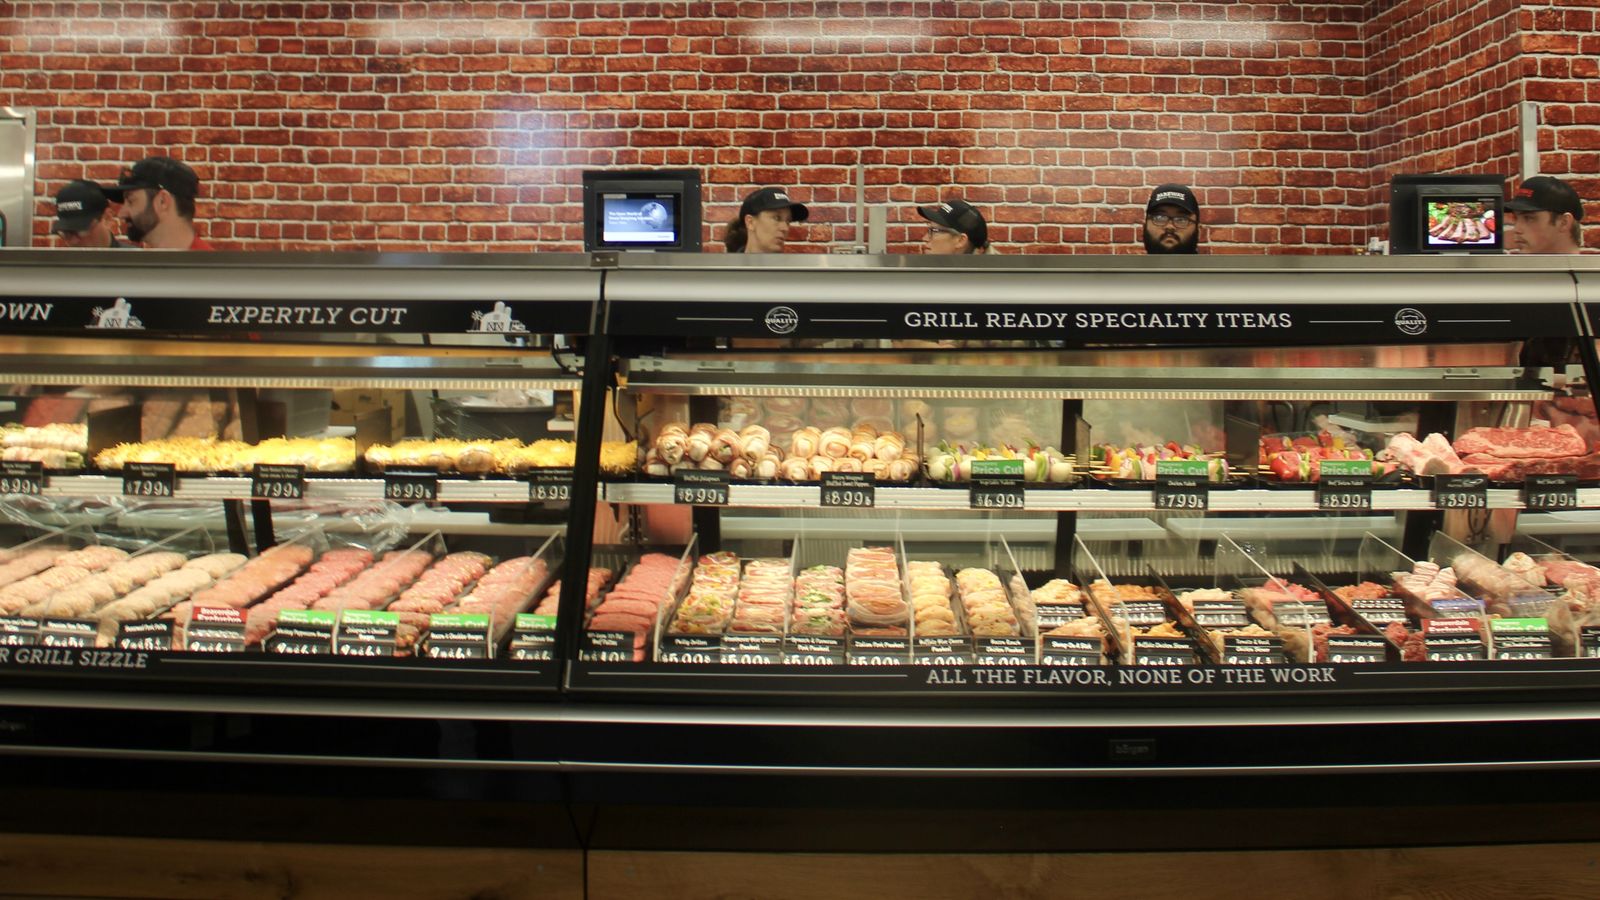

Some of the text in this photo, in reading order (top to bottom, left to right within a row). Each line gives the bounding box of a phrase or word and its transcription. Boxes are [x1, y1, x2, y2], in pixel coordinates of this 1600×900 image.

[208, 306, 407, 325] EXPERTLY CUT
[904, 312, 1293, 328] GRILL READY SPECIALTY ITEMS
[973, 465, 1023, 475] Price Cut
[1157, 467, 1208, 475] Price Cut
[1321, 466, 1371, 475] Price Cut
[15, 648, 74, 666] GRILL
[79, 650, 148, 668] SIZZLE
[926, 667, 1336, 686] ALL THE FLAVOR, NONE OF THE WORK
